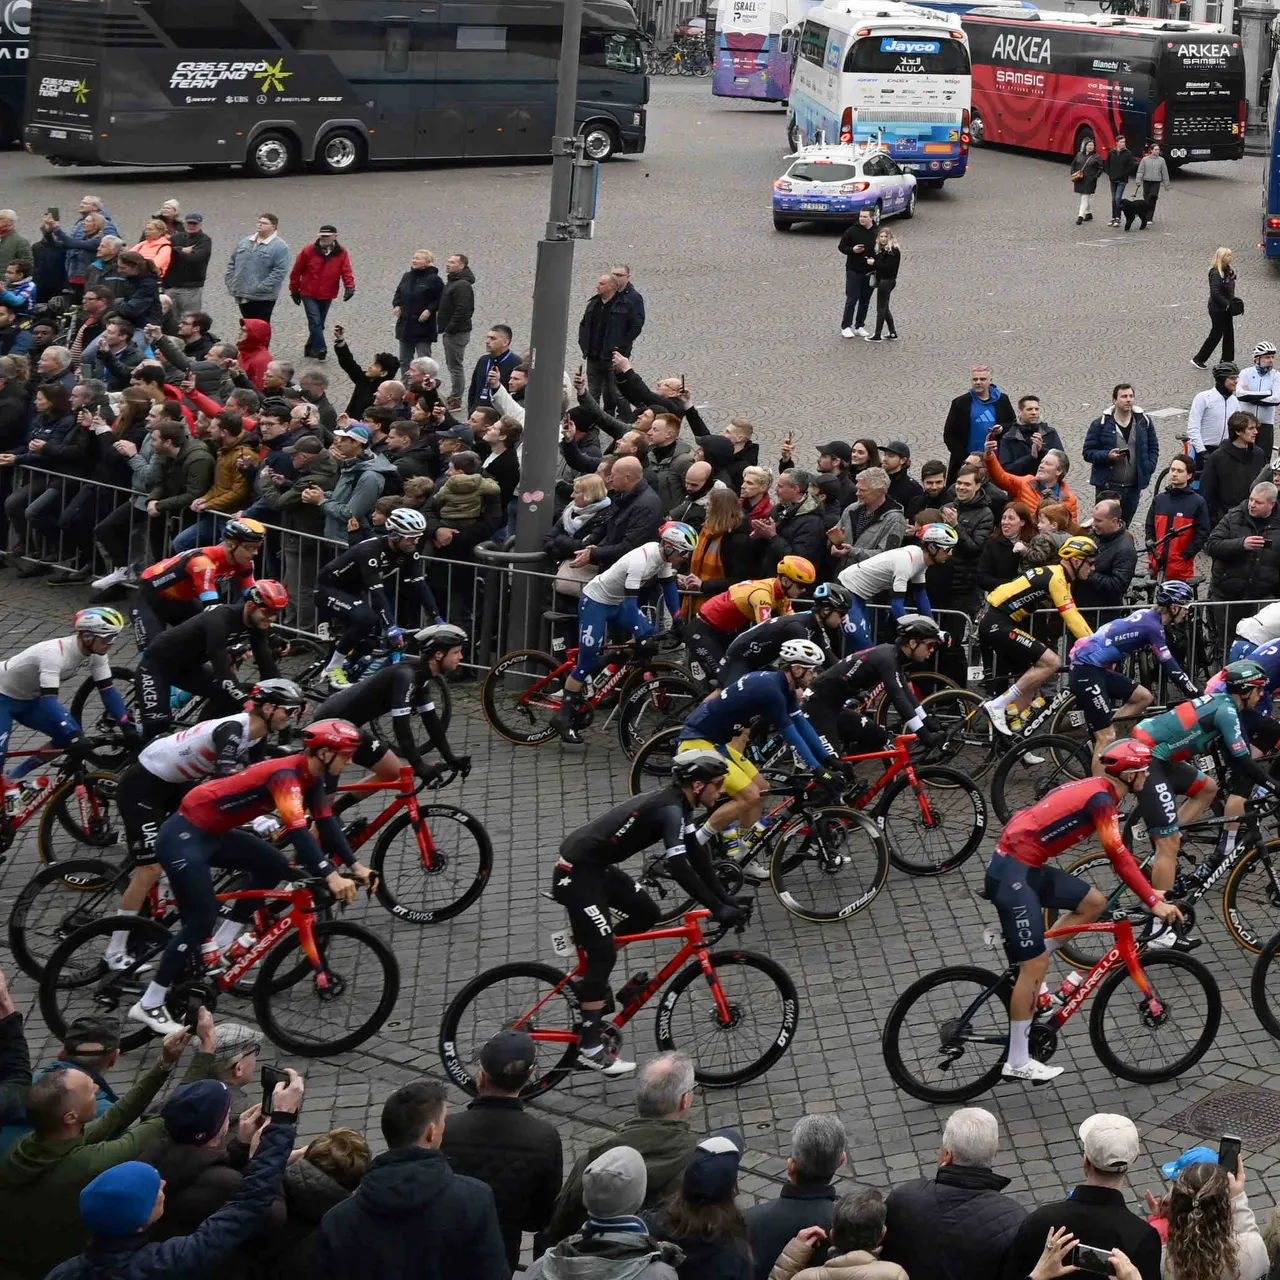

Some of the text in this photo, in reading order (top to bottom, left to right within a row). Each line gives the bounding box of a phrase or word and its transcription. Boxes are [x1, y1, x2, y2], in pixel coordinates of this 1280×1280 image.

[734, 1, 756, 11] ISRAEL
[885, 40, 936, 53] Jayco
[991, 33, 1051, 65] ARKEA
[1177, 44, 1231, 57] ARKEA
[231, 62, 269, 72] PRO
[894, 65, 926, 73] ALULA
[1092, 59, 1119, 70] Bianchi
[169, 80, 218, 89] TEAM
[172, 71, 248, 81] CYCLING
[996, 70, 1044, 87] SAMSIC
[1013, 627, 1036, 642] JUMBO
[1015, 635, 1033, 649] VISMA
[1114, 631, 1139, 642] FACTOR
[972, 672, 981, 680] 27
[140, 673, 159, 710] ARKEA
[1023, 689, 1071, 737] cervélo
[1167, 729, 1202, 750] hansgrohe
[970, 789, 984, 813] SWISS
[1154, 782, 1177, 824] BORA
[141, 821, 155, 848] UAE
[1193, 843, 1246, 900] S-WORKS
[392, 904, 434, 921] DT SWISS
[583, 904, 612, 937] BMC
[1012, 905, 1034, 948] INEOS
[223, 917, 292, 982] PINARELLO
[554, 935, 566, 952] 243
[1062, 948, 1120, 1018] PINARELLO
[659, 1009, 672, 1040] SWISS
[777, 998, 795, 1047] DT SWISS
[444, 1041, 471, 1086] DT SWISS
